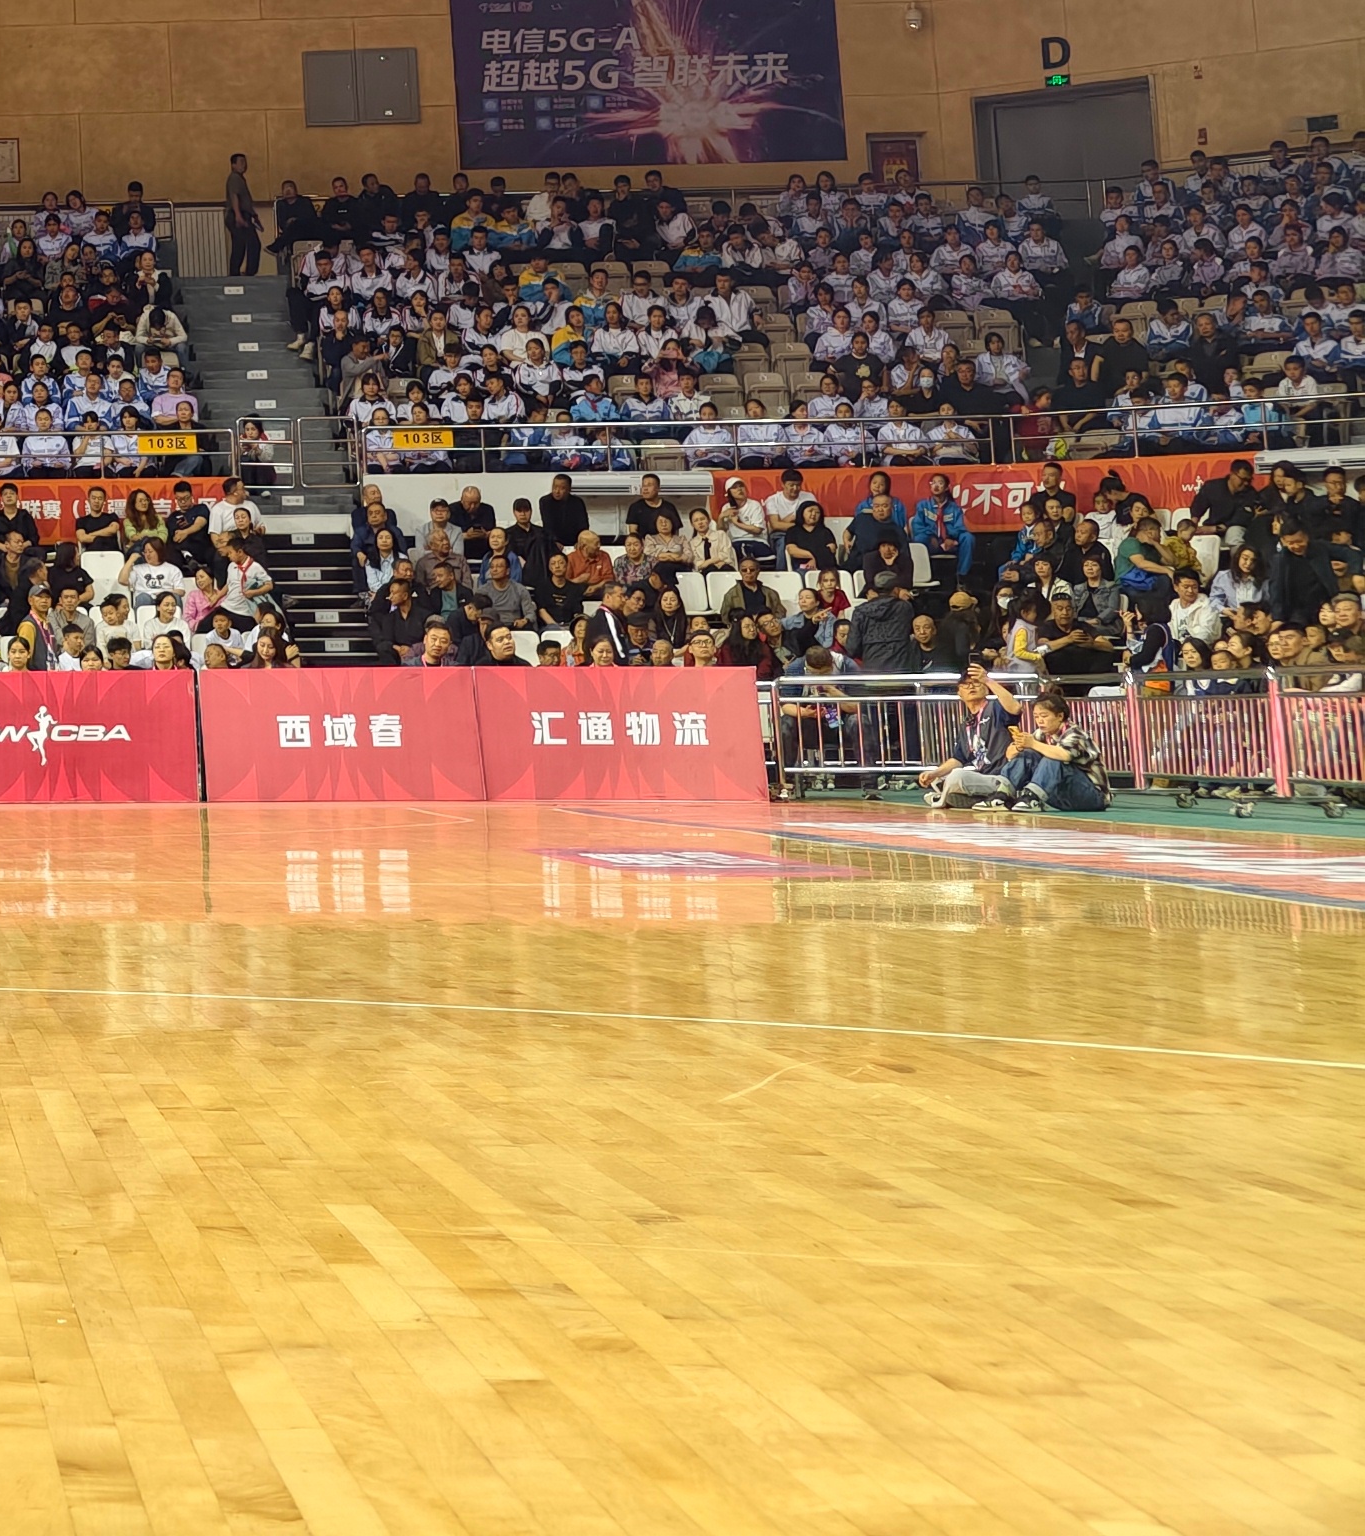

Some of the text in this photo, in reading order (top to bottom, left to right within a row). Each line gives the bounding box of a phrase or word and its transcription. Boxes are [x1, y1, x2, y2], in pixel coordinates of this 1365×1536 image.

[480, 27, 641, 55] 电信5G-A
[1040, 36, 1071, 70] D
[481, 51, 790, 92] 超越5G 智联未来
[146, 437, 189, 450] 103区
[402, 430, 445, 444] 103区
[276, 714, 402, 748] 西域春
[530, 711, 710, 747] 汇通物流
